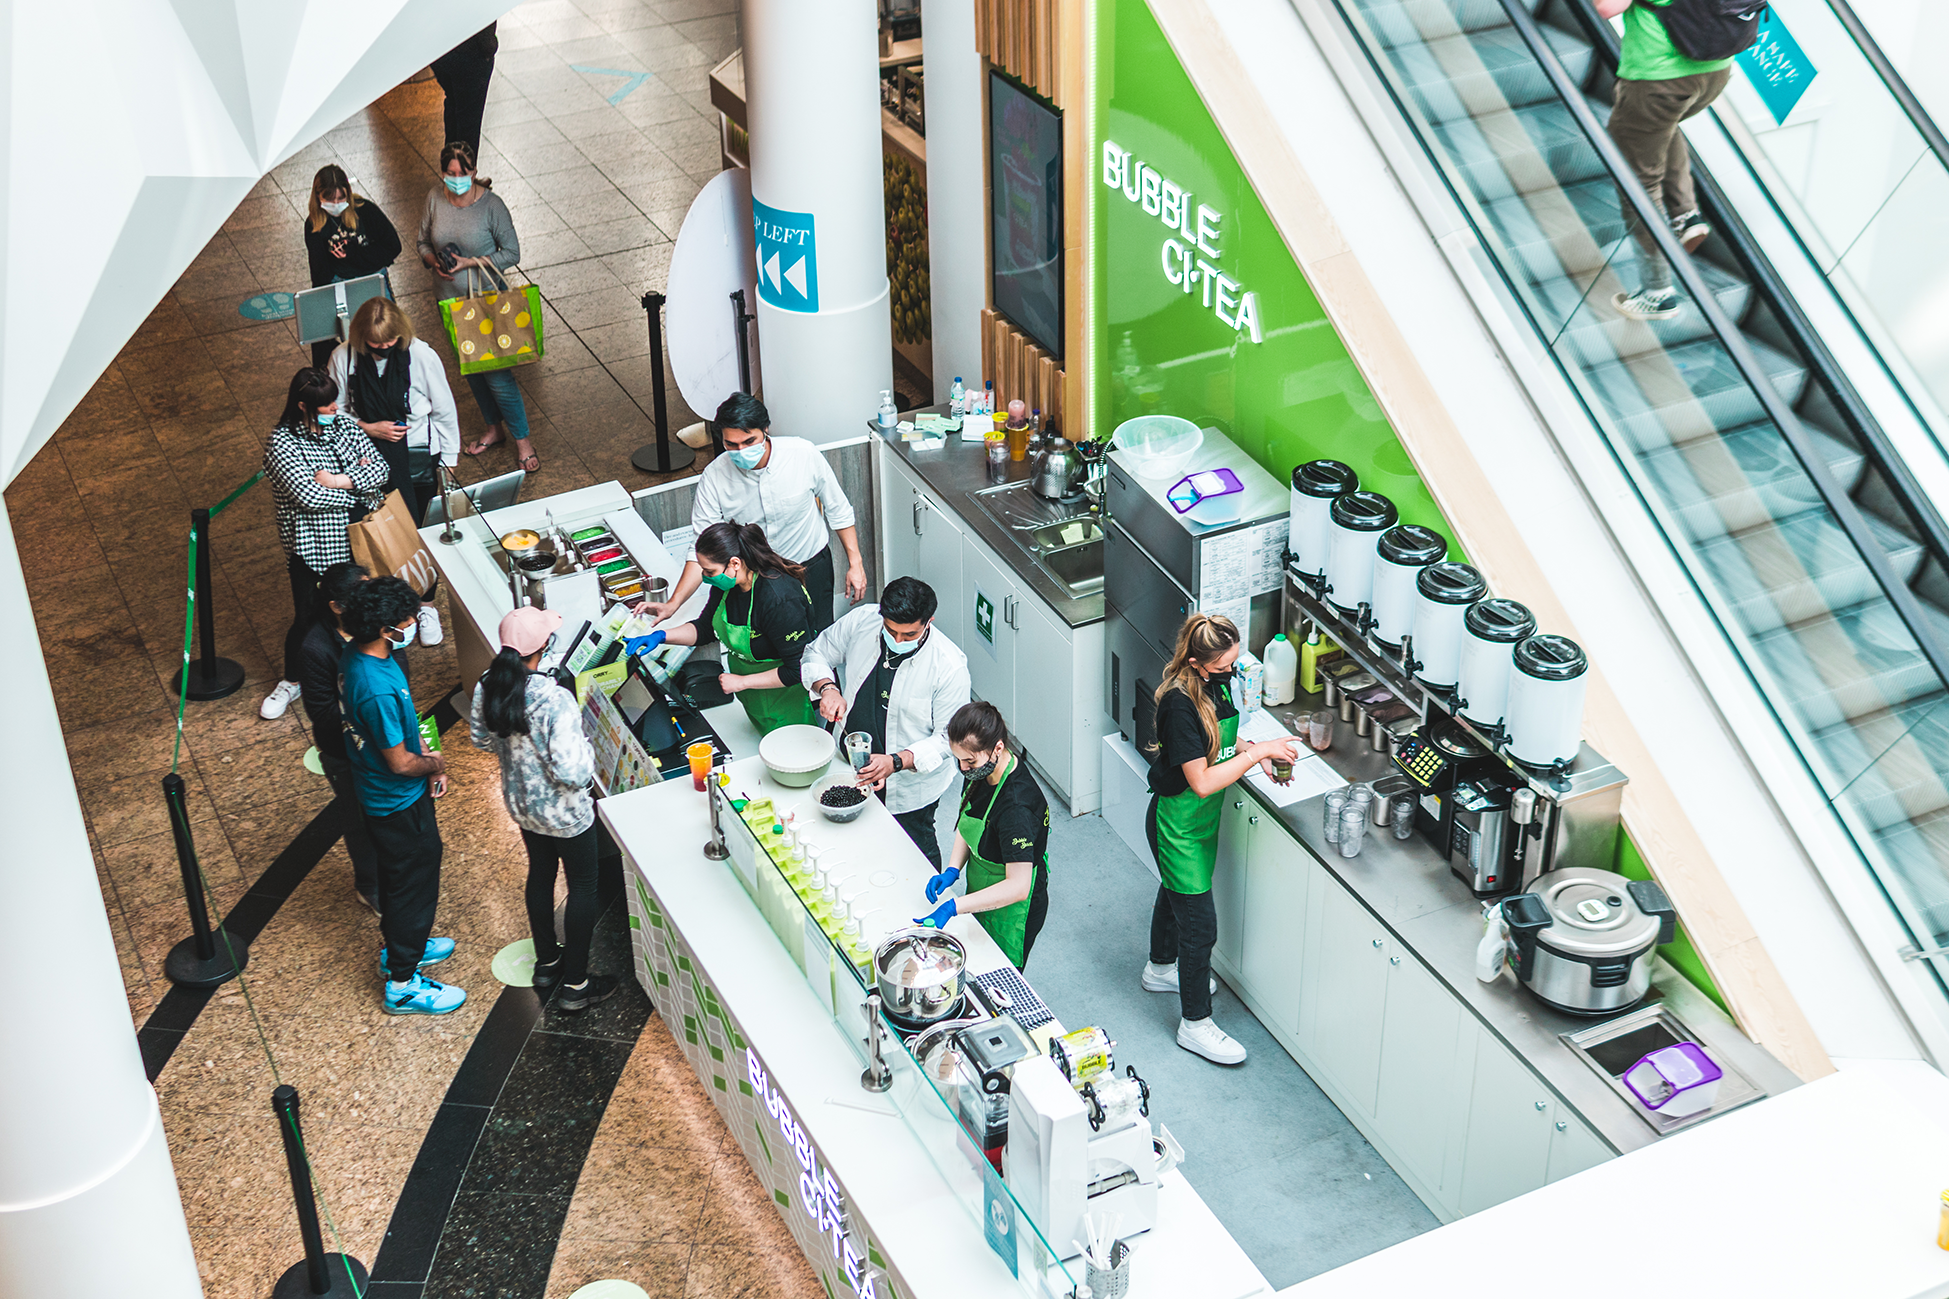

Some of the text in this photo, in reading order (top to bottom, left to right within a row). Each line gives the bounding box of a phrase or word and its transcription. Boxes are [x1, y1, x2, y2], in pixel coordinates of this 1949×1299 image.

[1748, 44, 1782, 87] ANCE
[763, 221, 810, 246] LEFT
[1103, 140, 1222, 259] BUBBLE
[746, 1046, 842, 1222] BUBBLE
